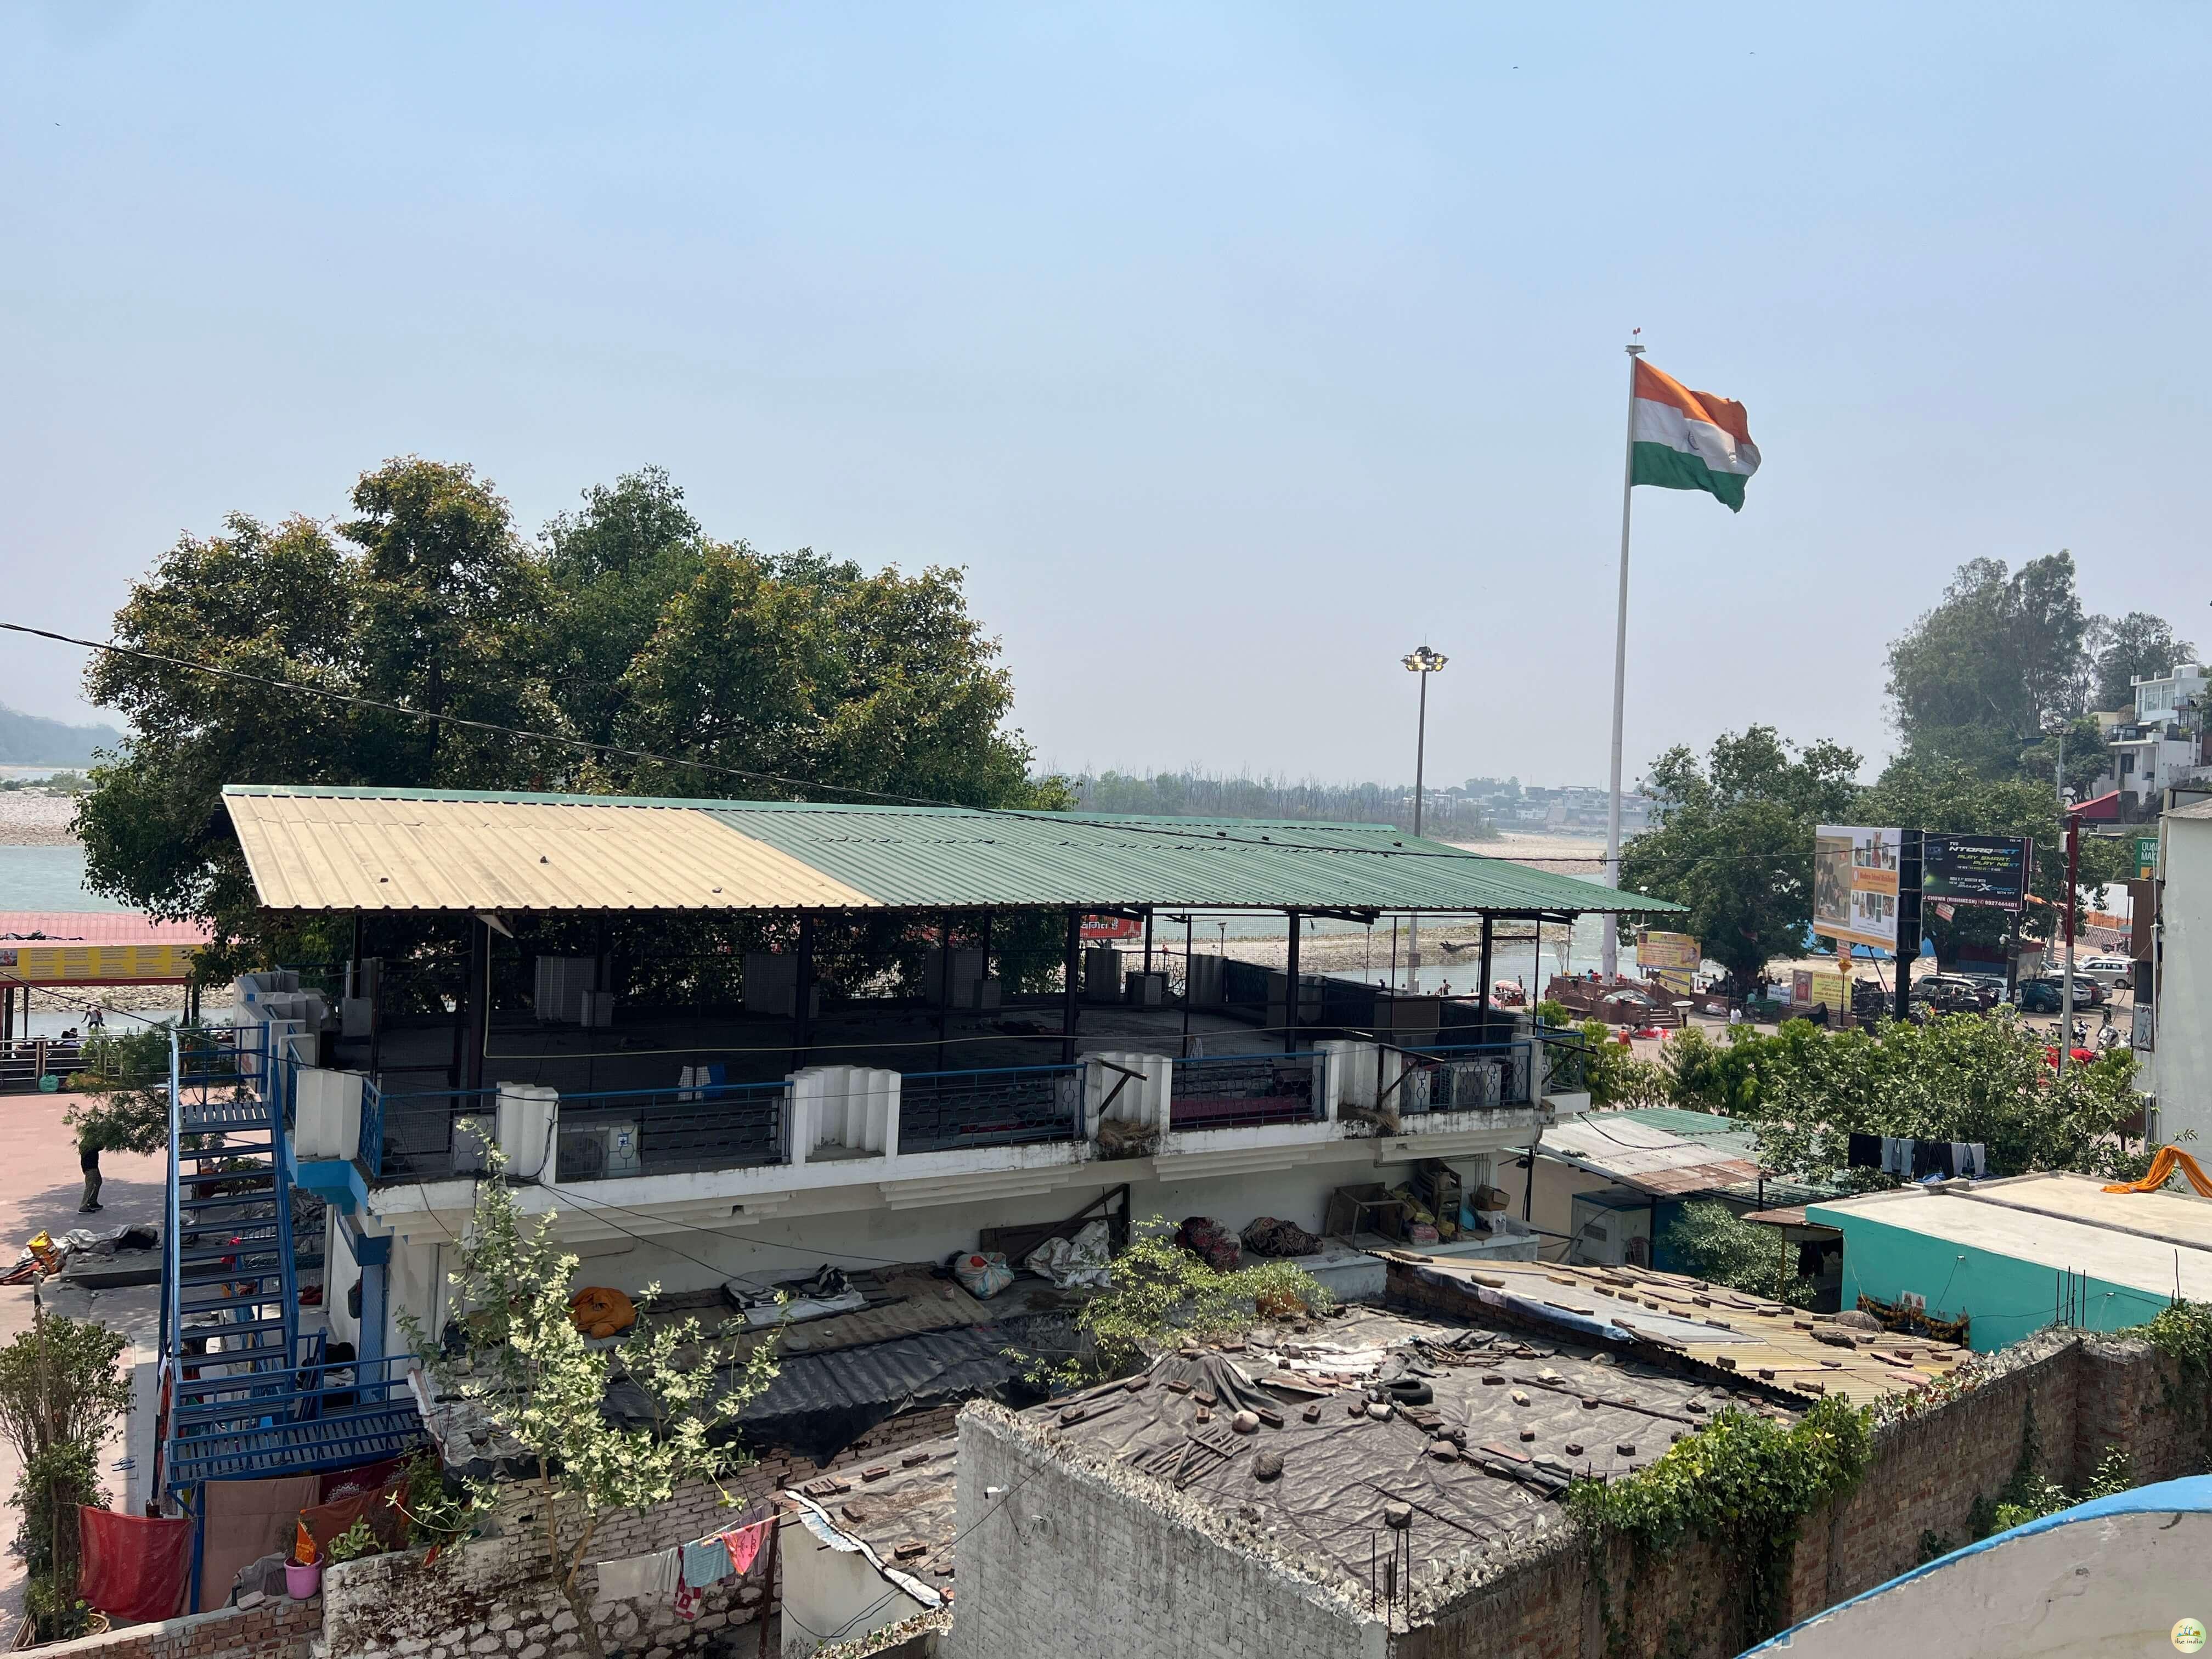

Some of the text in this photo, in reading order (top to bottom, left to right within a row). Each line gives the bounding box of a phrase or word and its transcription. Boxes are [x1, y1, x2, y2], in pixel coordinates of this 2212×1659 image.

[1949, 846, 1993, 854] NTORQ
[2142, 842, 2159, 852] QUAL
[2141, 851, 2158, 861] MAK
